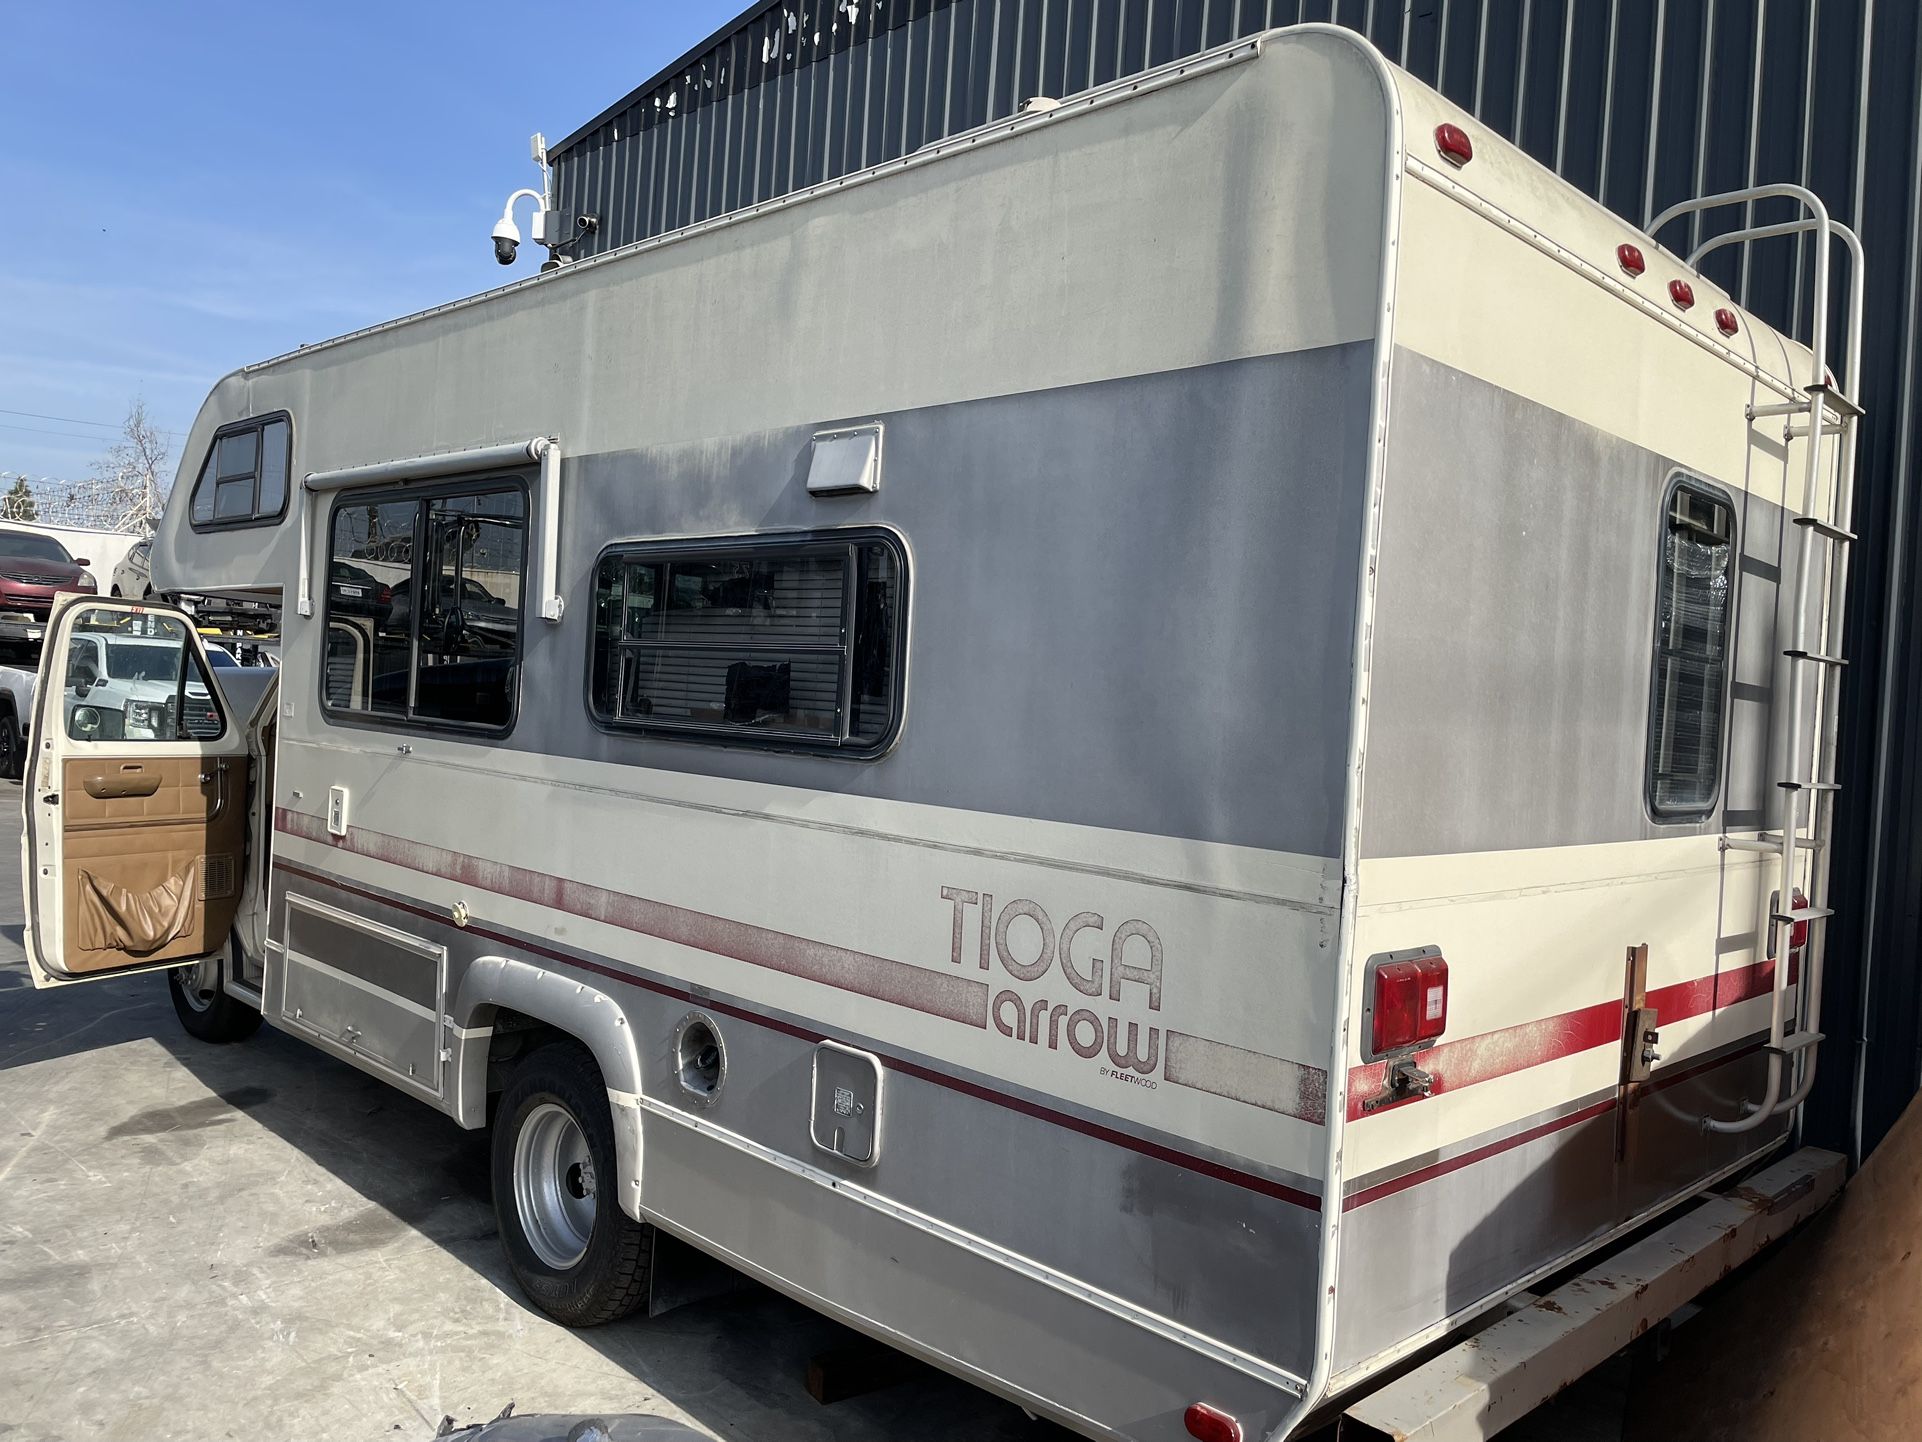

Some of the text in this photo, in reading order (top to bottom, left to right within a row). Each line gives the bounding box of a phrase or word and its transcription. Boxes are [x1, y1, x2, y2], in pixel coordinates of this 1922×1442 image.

[131, 606, 145, 614] EXIT
[941, 885, 1163, 1011] TIOGA
[992, 989, 1160, 1075] arrow
[1099, 1066, 1158, 1090] BY FLEETWOOD
